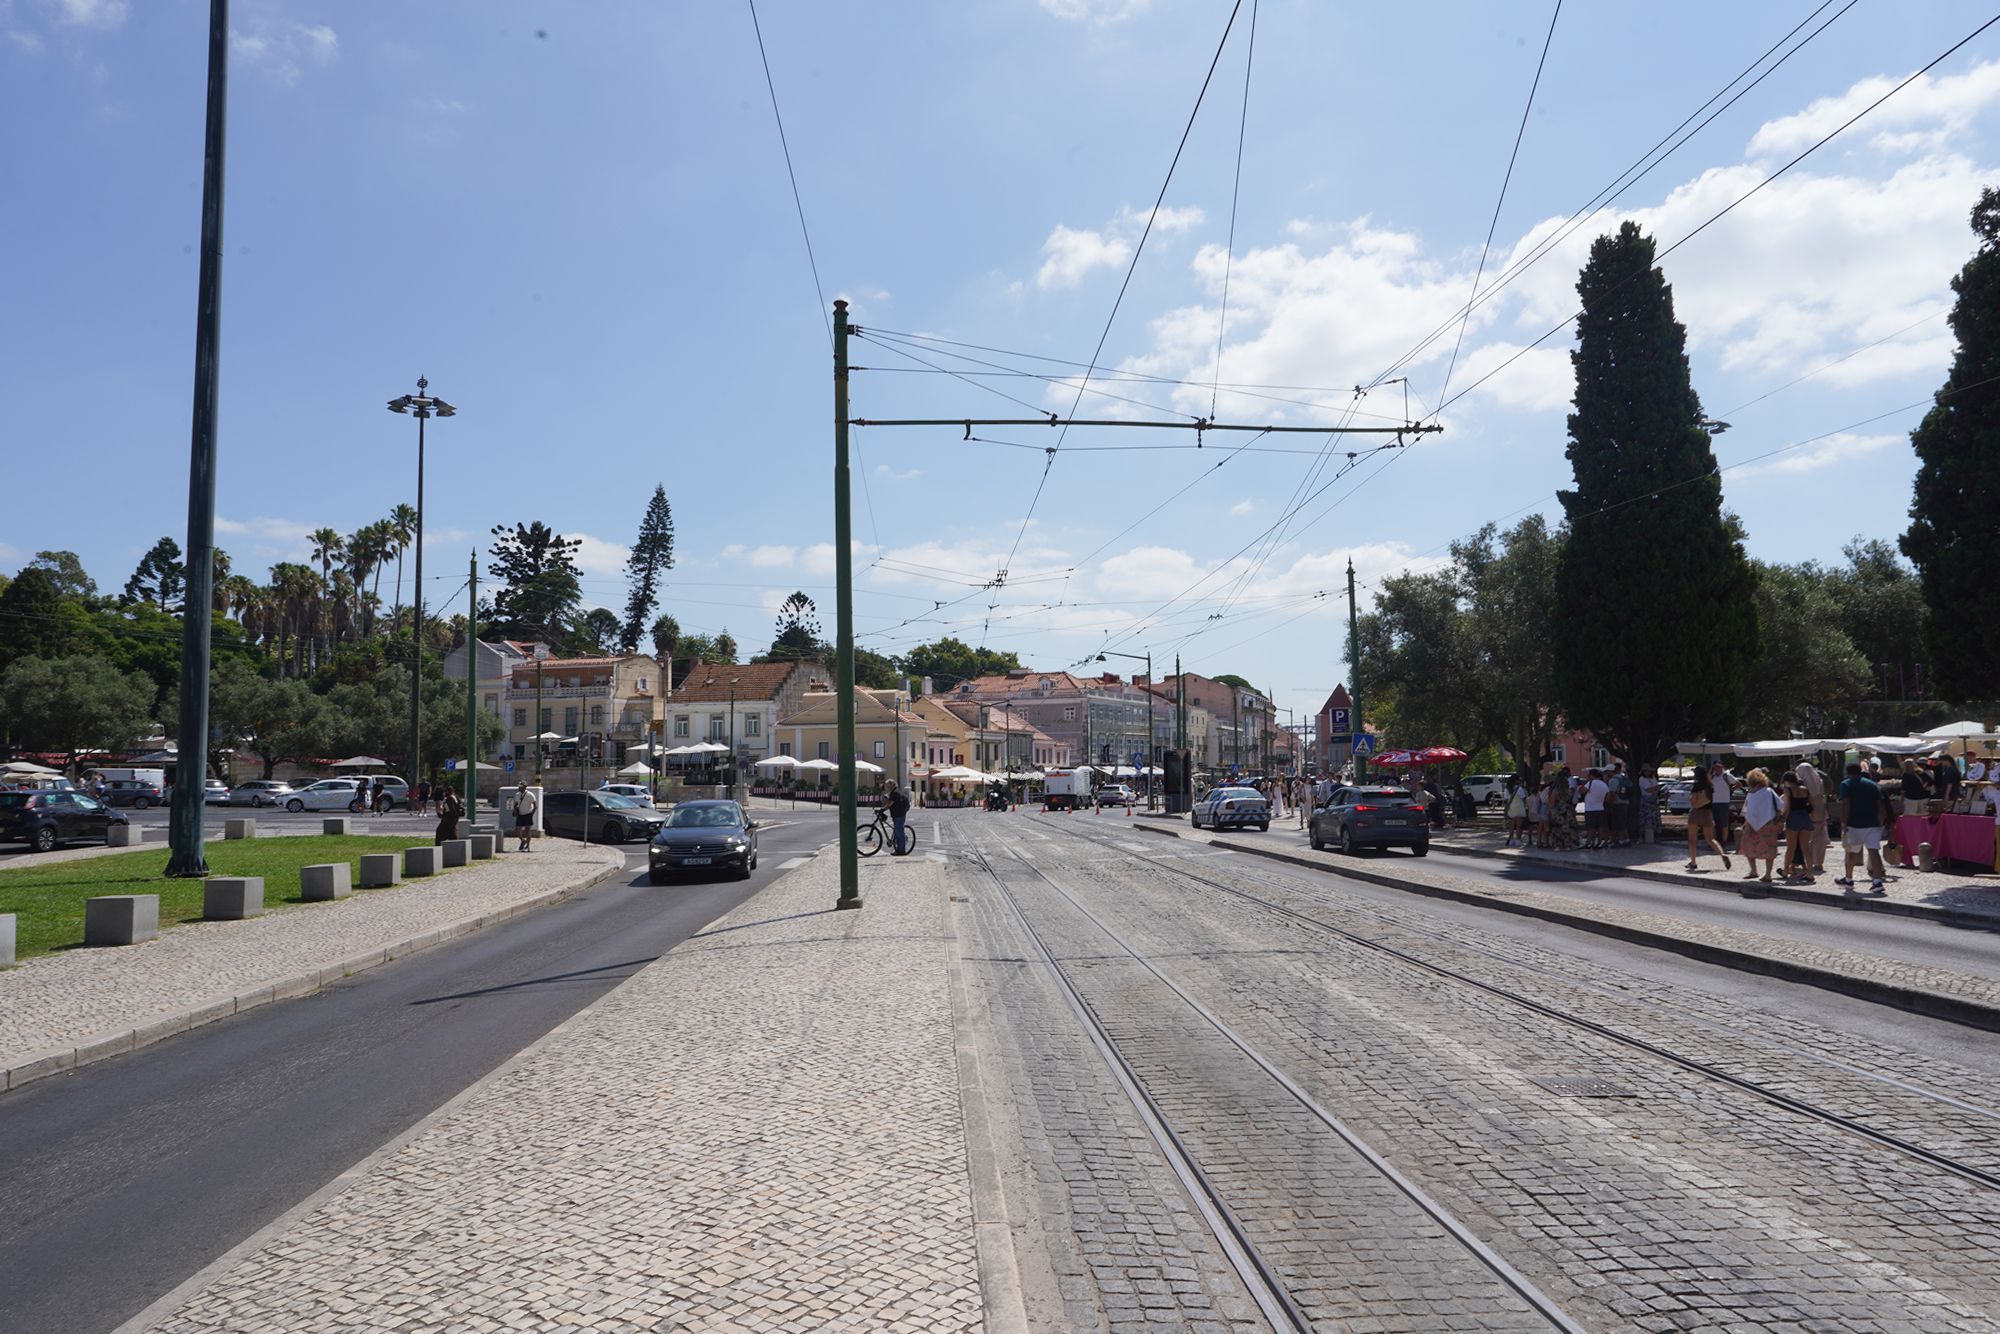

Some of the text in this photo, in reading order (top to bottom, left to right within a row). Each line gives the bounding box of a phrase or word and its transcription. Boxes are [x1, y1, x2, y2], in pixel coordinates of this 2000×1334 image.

[1336, 710, 1345, 722] P
[447, 760, 454, 769] P
[507, 762, 513, 771] P
